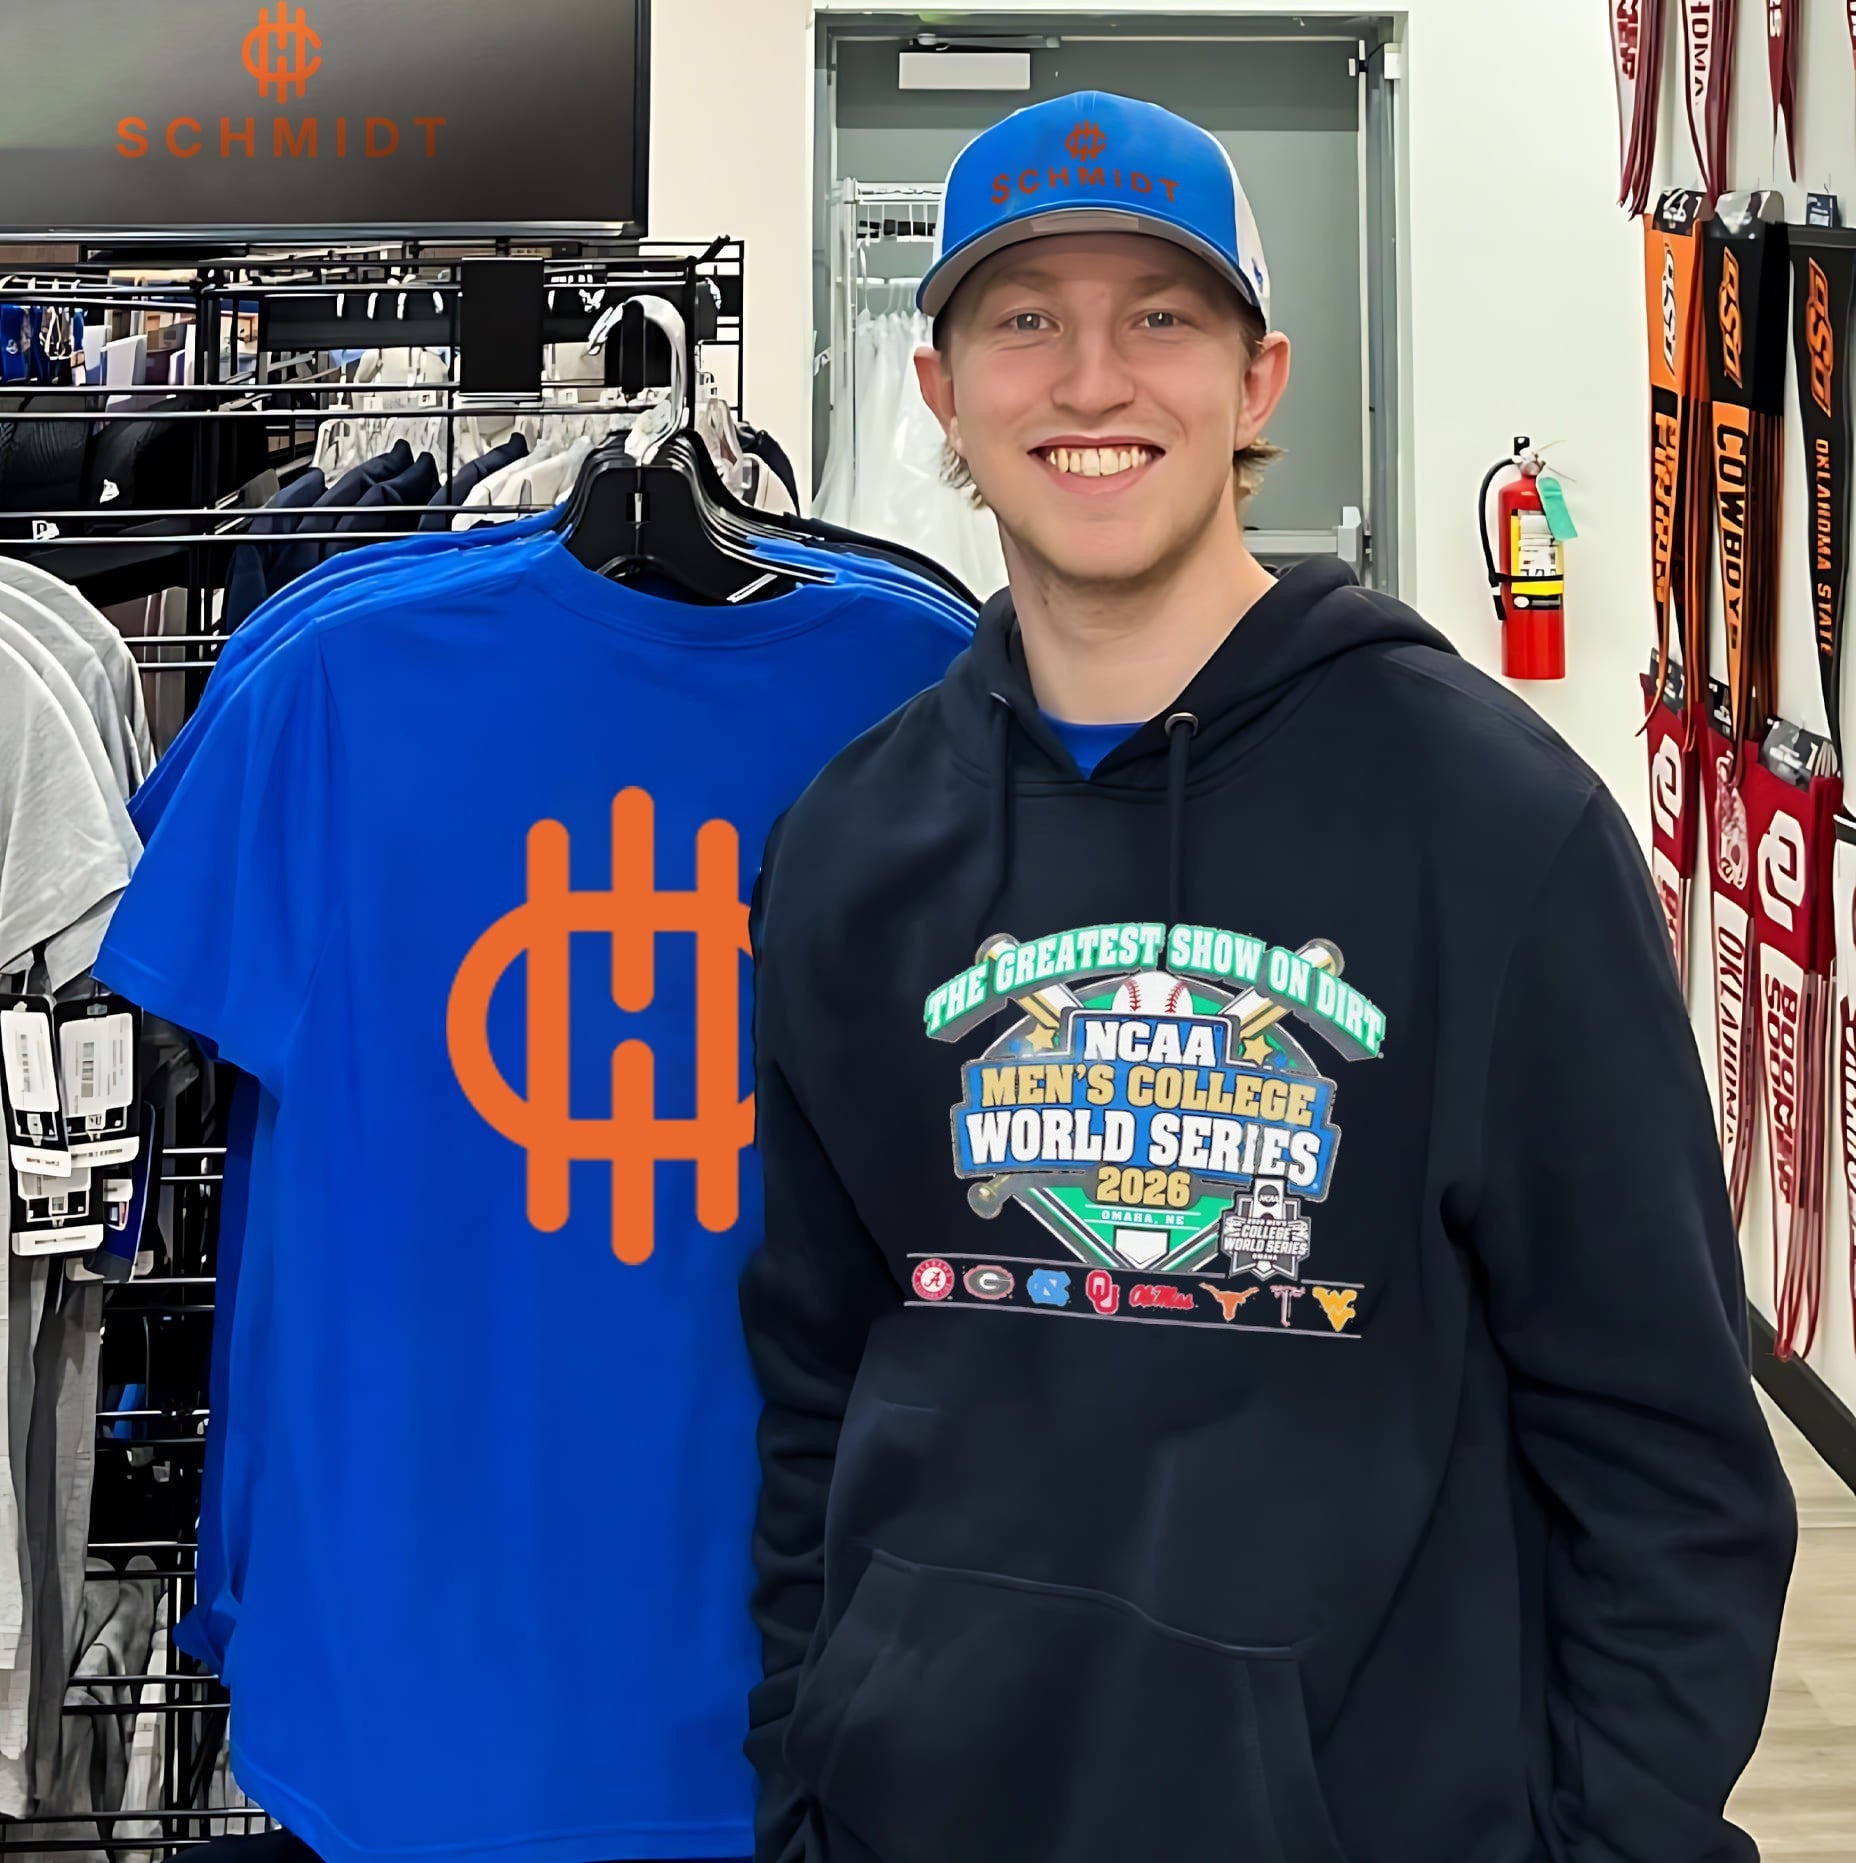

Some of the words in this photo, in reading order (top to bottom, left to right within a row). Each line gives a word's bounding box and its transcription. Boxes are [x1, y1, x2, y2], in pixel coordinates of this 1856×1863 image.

[115, 115, 447, 159] SCHMIDT
[991, 166, 1179, 205] SCHMIDT
[1815, 438, 1832, 570] OKLAHOMA
[926, 963, 990, 1033] THE
[995, 924, 1165, 993] GREATEST
[1169, 926, 1264, 981] SHOW
[1268, 948, 1313, 999] ON
[1316, 970, 1386, 1054] DIRT
[1084, 1020, 1217, 1067] NCAA
[1718, 925, 1746, 1144] OKLAHOMA
[980, 1064, 1116, 1108] MEN'S
[1127, 1065, 1317, 1127] COLLEGE
[965, 1108, 1136, 1164] WORLD
[1148, 1115, 1322, 1187] SERIES
[1096, 1165, 1191, 1208] 2026
[1101, 1209, 1158, 1224] OMAHA,
[1165, 1214, 1185, 1226] NE
[1241, 1224, 1292, 1240] COLLEGE
[1223, 1237, 1265, 1253] WORLD
[1264, 1239, 1309, 1255] SERIES
[1252, 1253, 1278, 1261] OMAHA
